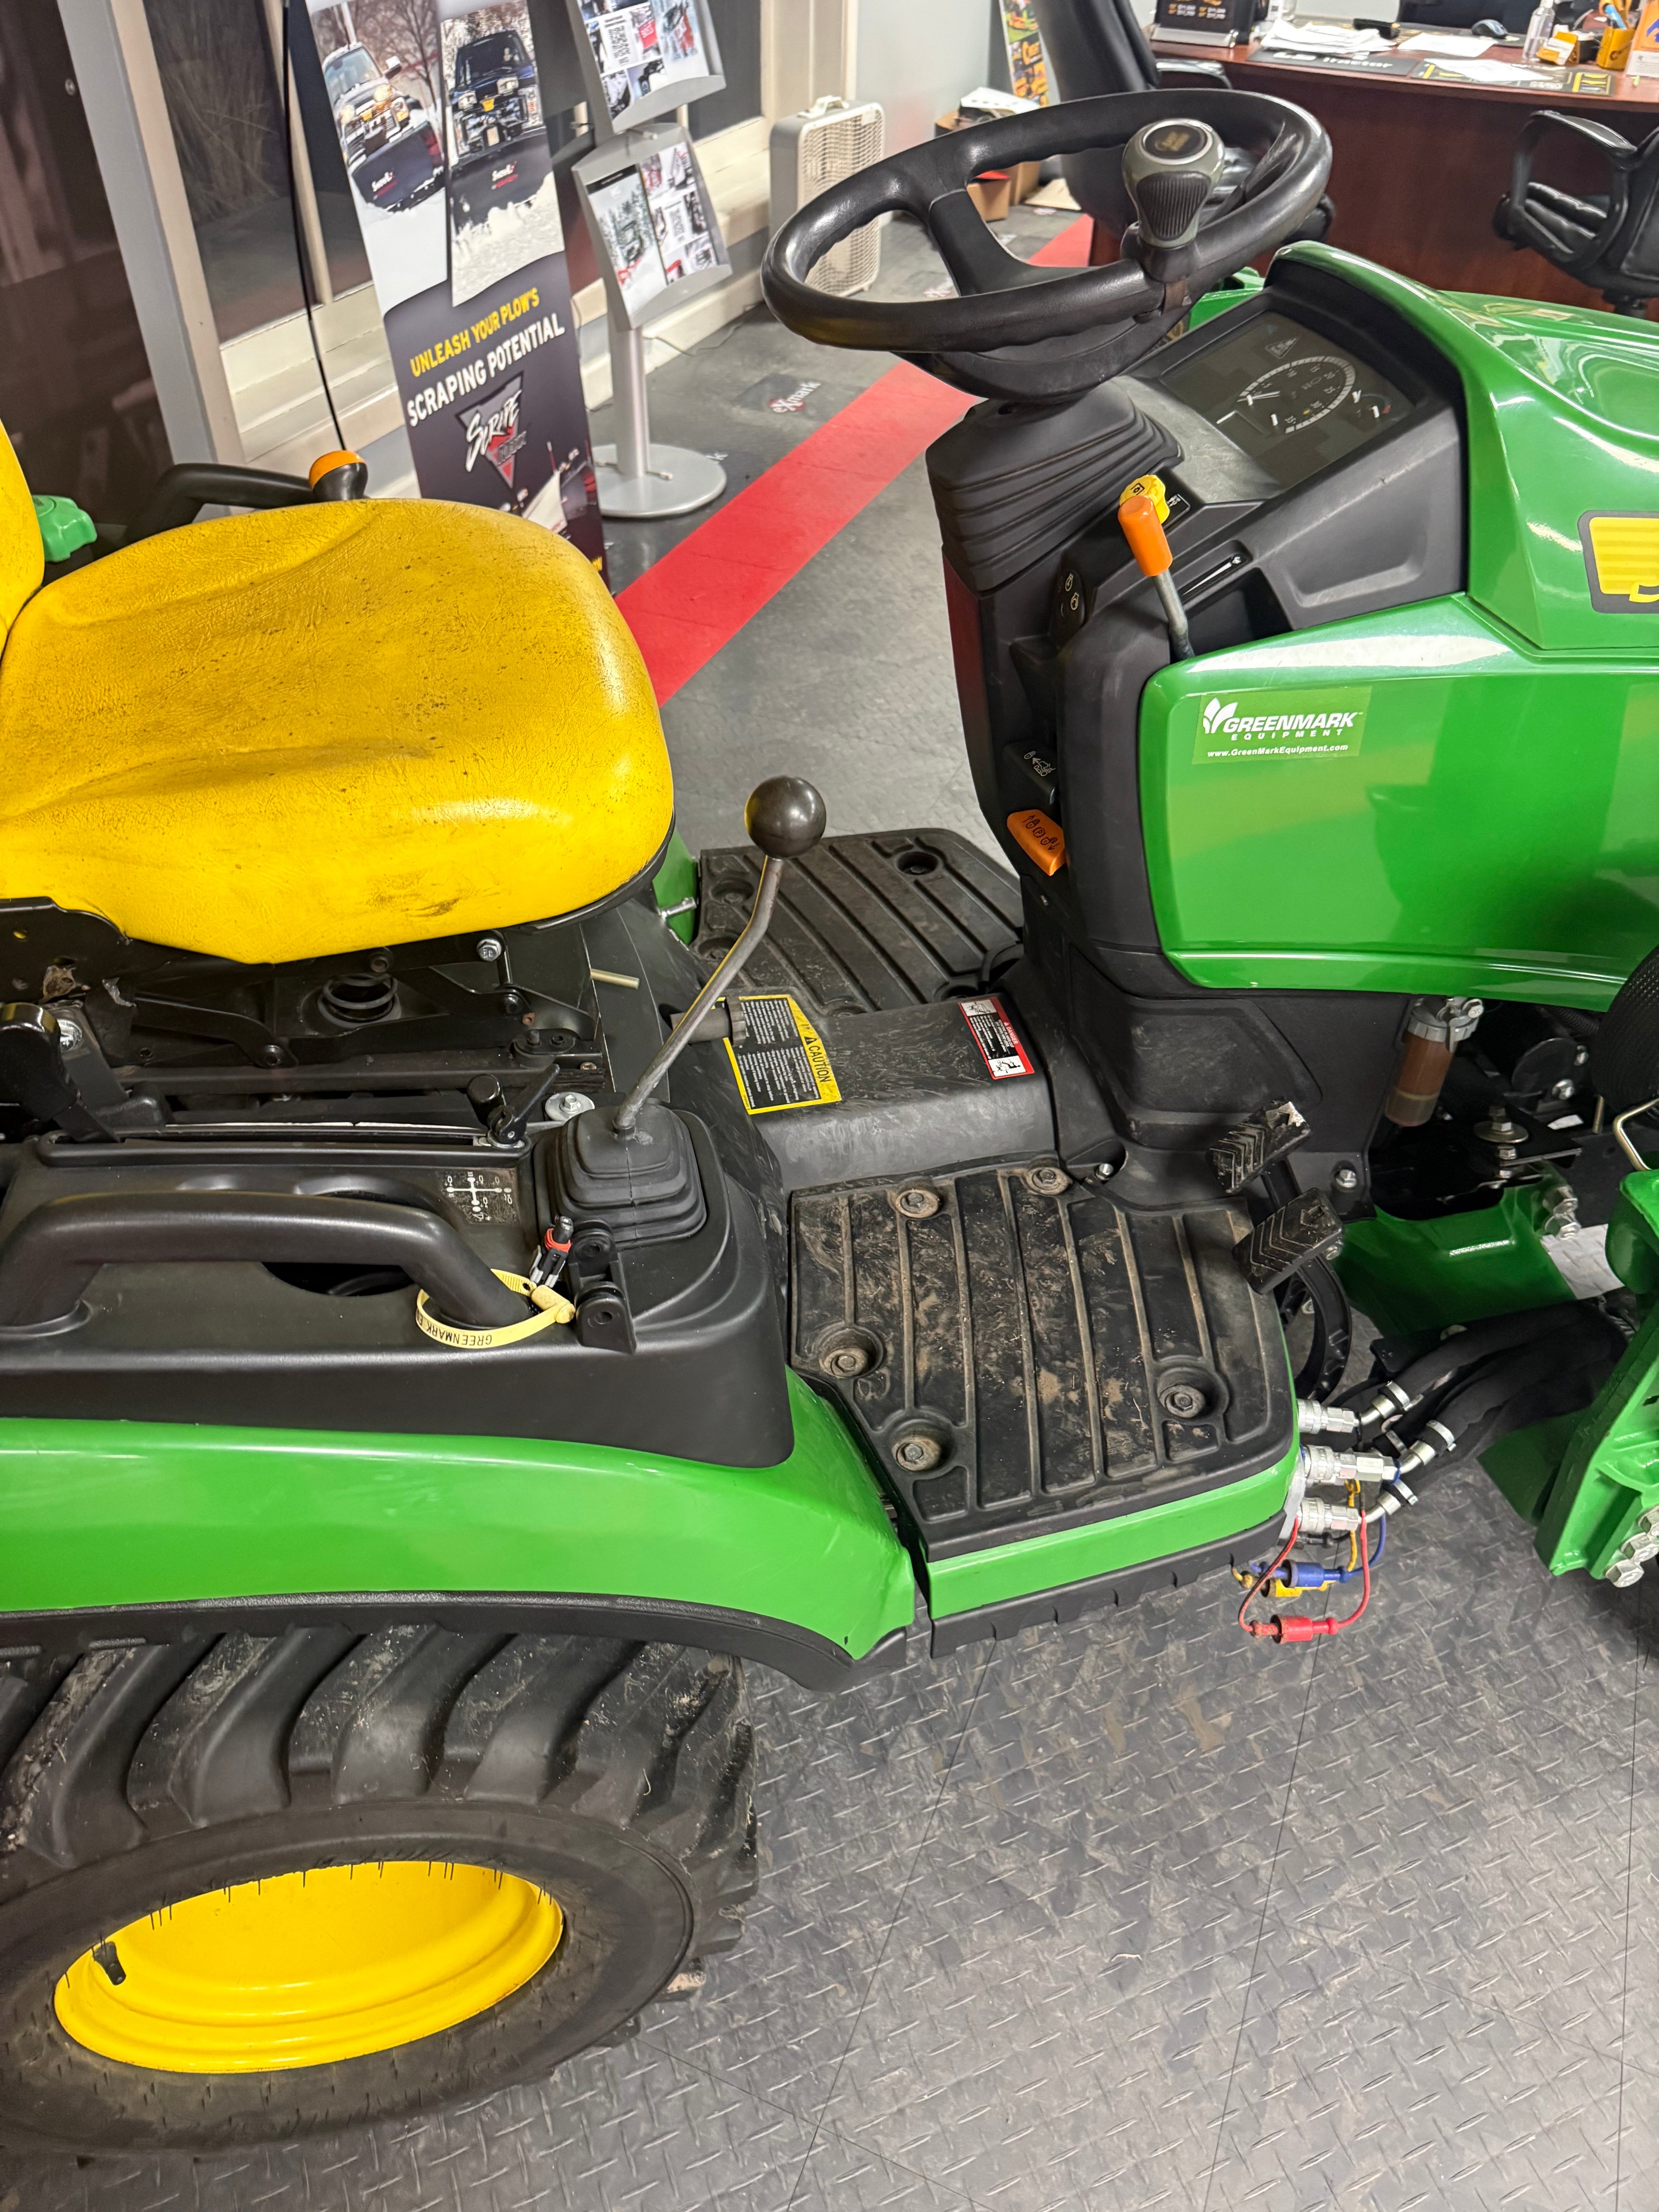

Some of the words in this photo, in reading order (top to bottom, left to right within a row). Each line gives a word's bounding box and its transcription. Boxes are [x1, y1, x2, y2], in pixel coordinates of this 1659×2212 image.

[410, 331, 471, 378] UNLEASH
[471, 315, 500, 344] YOUR
[500, 287, 540, 325] PLOW'S
[407, 359, 487, 426] SCRAPING
[487, 313, 565, 378] POTENTIAL
[1223, 712, 1358, 733] GREENMARK
[1231, 729, 1343, 741] EQUIPMENT
[1207, 744, 1348, 757] www.GreenMarkEquipment.com
[1006, 1027, 1019, 1044] DANGER
[809, 1046, 831, 1083] CAUTION
[426, 1320, 492, 1346] GREENMARK
